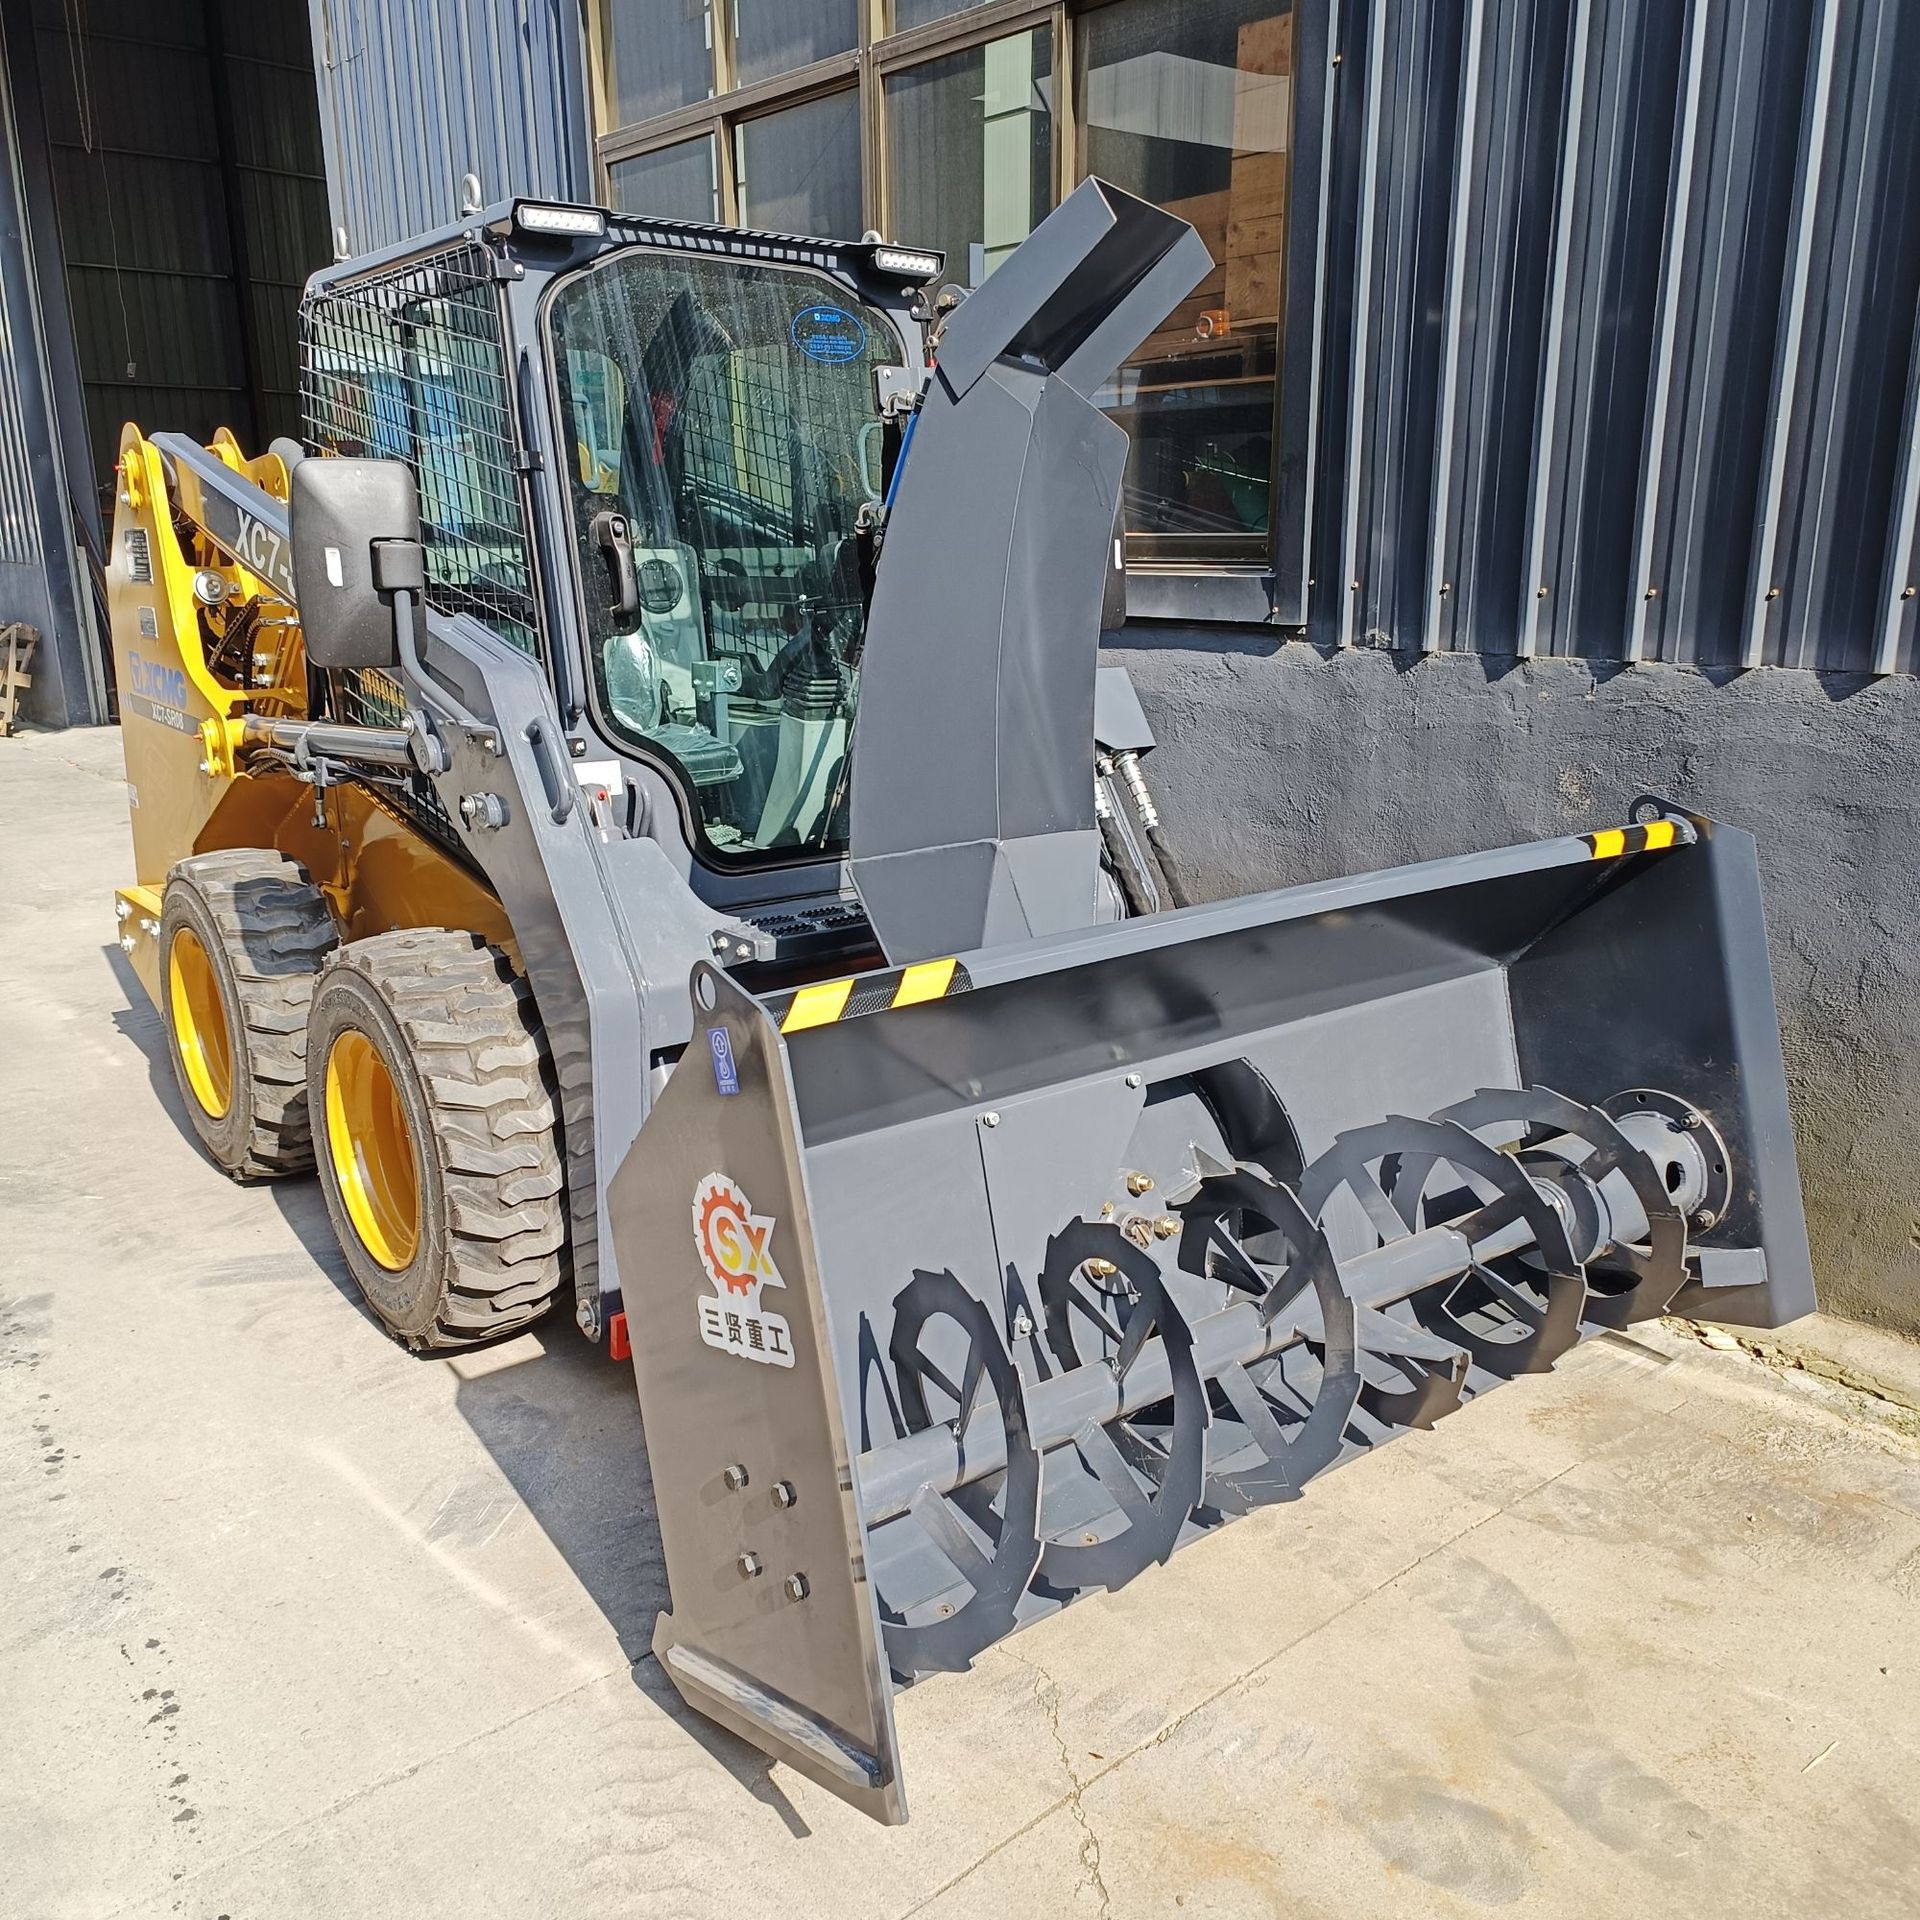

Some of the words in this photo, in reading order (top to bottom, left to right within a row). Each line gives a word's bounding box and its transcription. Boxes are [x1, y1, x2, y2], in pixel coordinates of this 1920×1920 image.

[143, 661, 188, 710] XCMG
[151, 702, 184, 730] XC7-SR08
[705, 1308, 788, 1355] 三贤重工
